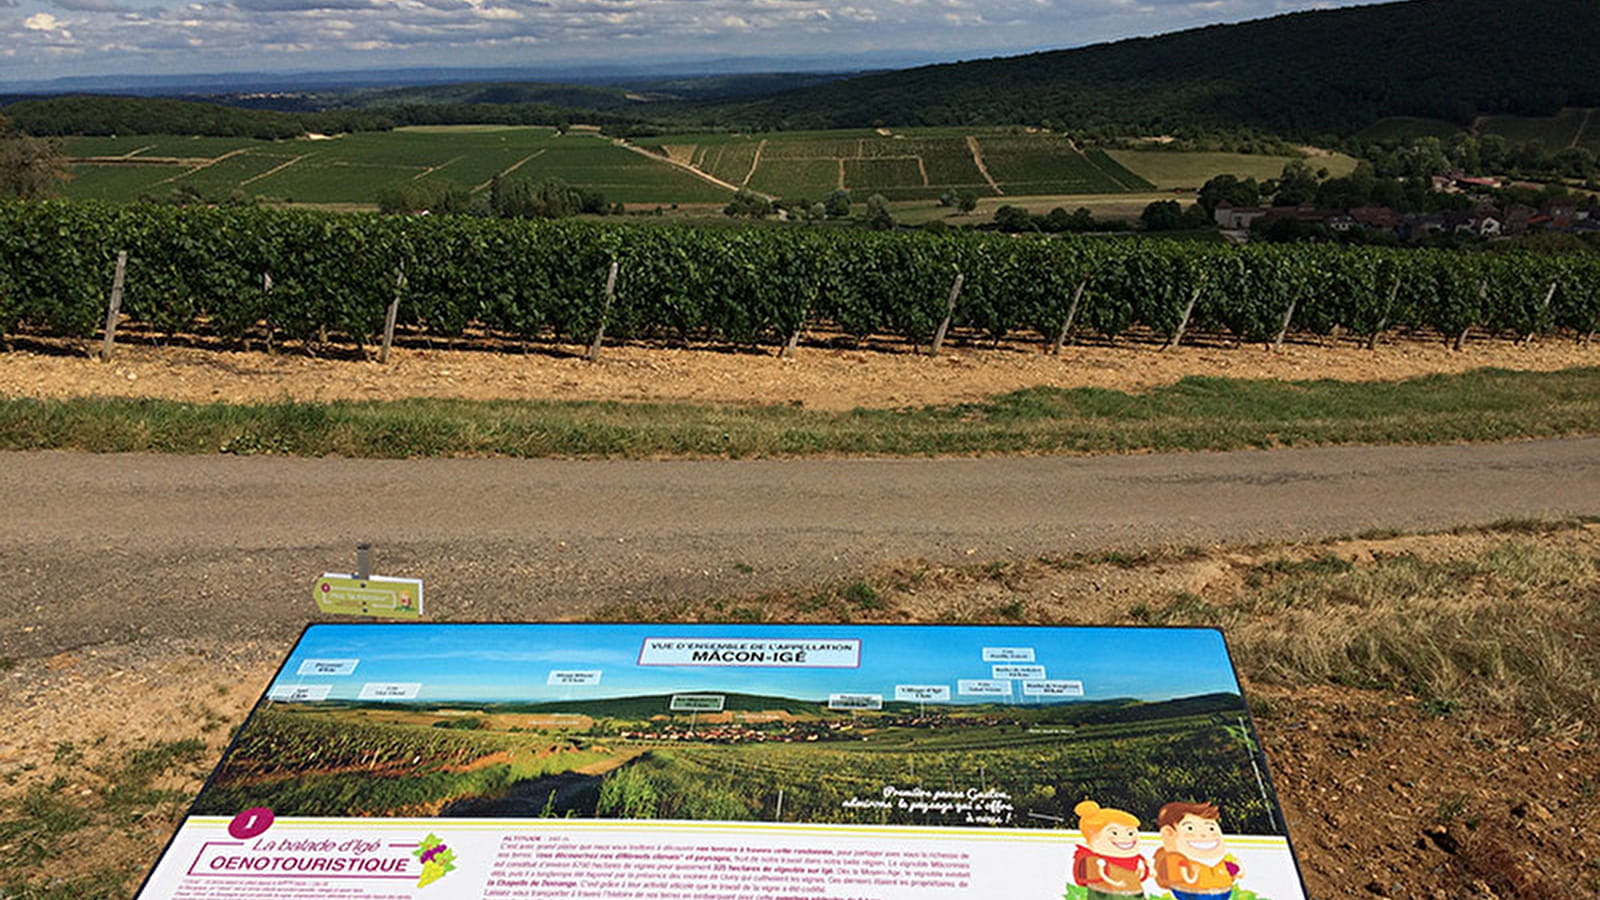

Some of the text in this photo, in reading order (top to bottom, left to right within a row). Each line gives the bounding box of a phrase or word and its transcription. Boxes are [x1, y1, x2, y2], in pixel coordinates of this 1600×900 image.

[768, 643, 853, 651] L'APPELLATION
[692, 649, 807, 663] MÂCON-IGÉ
[246, 816, 257, 829] 1
[252, 838, 382, 855] La balade d'Igé
[209, 856, 410, 873] OENOTOURISTIQUE
